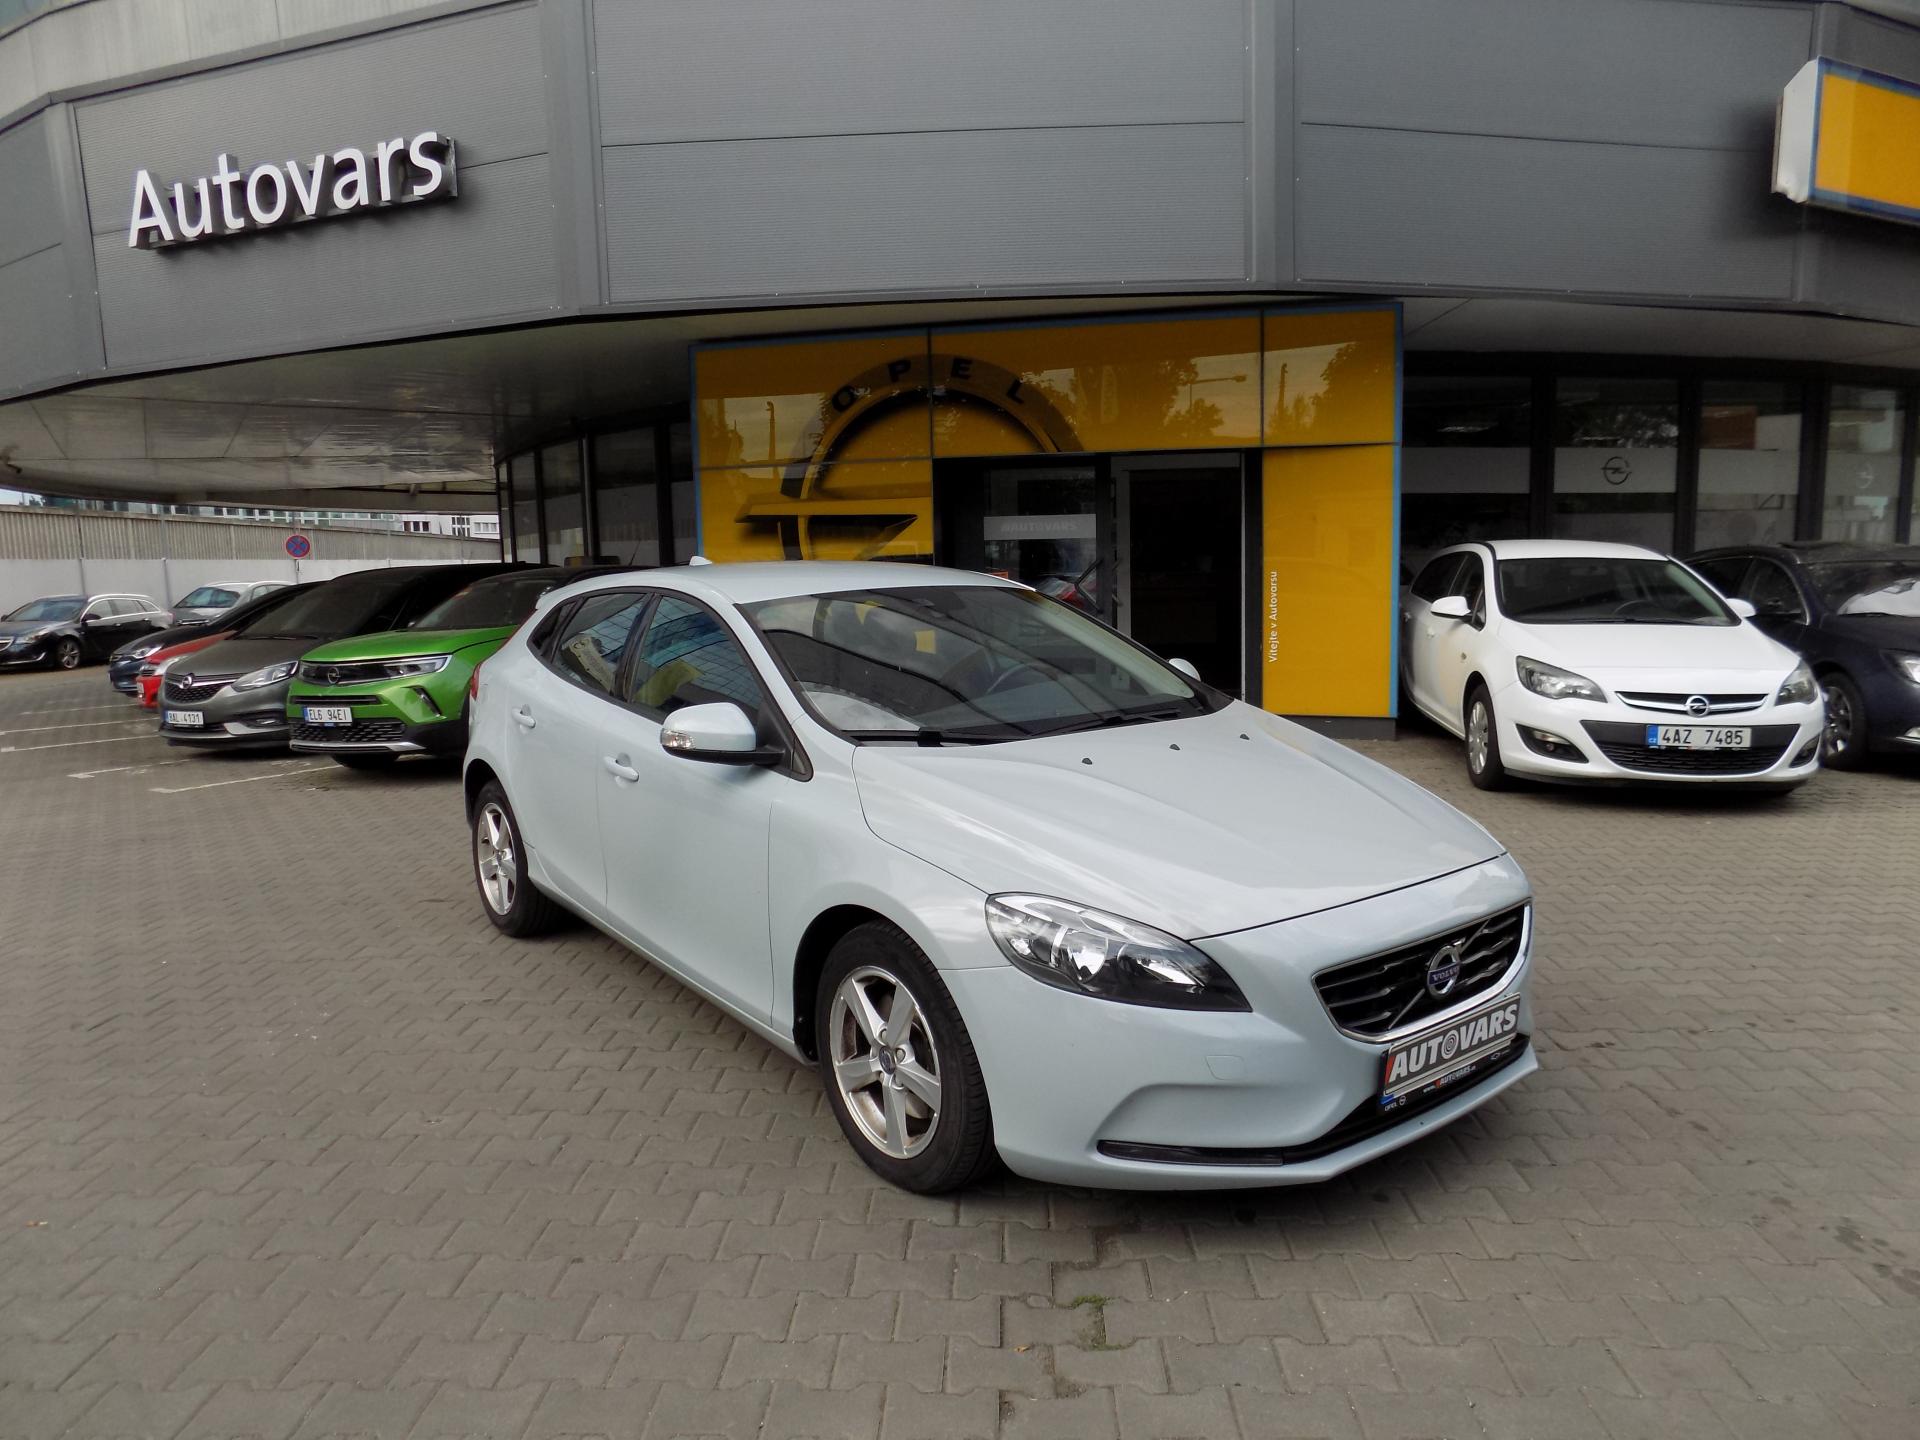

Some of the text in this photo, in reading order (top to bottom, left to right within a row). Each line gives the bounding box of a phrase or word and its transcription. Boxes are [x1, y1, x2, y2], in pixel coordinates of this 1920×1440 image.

[129, 131, 444, 248] Autovars
[831, 357, 1025, 412] OPEL
[1662, 728, 1743, 745] 4AZ 7485
[1389, 1003, 1518, 1083] AUTOVARS
